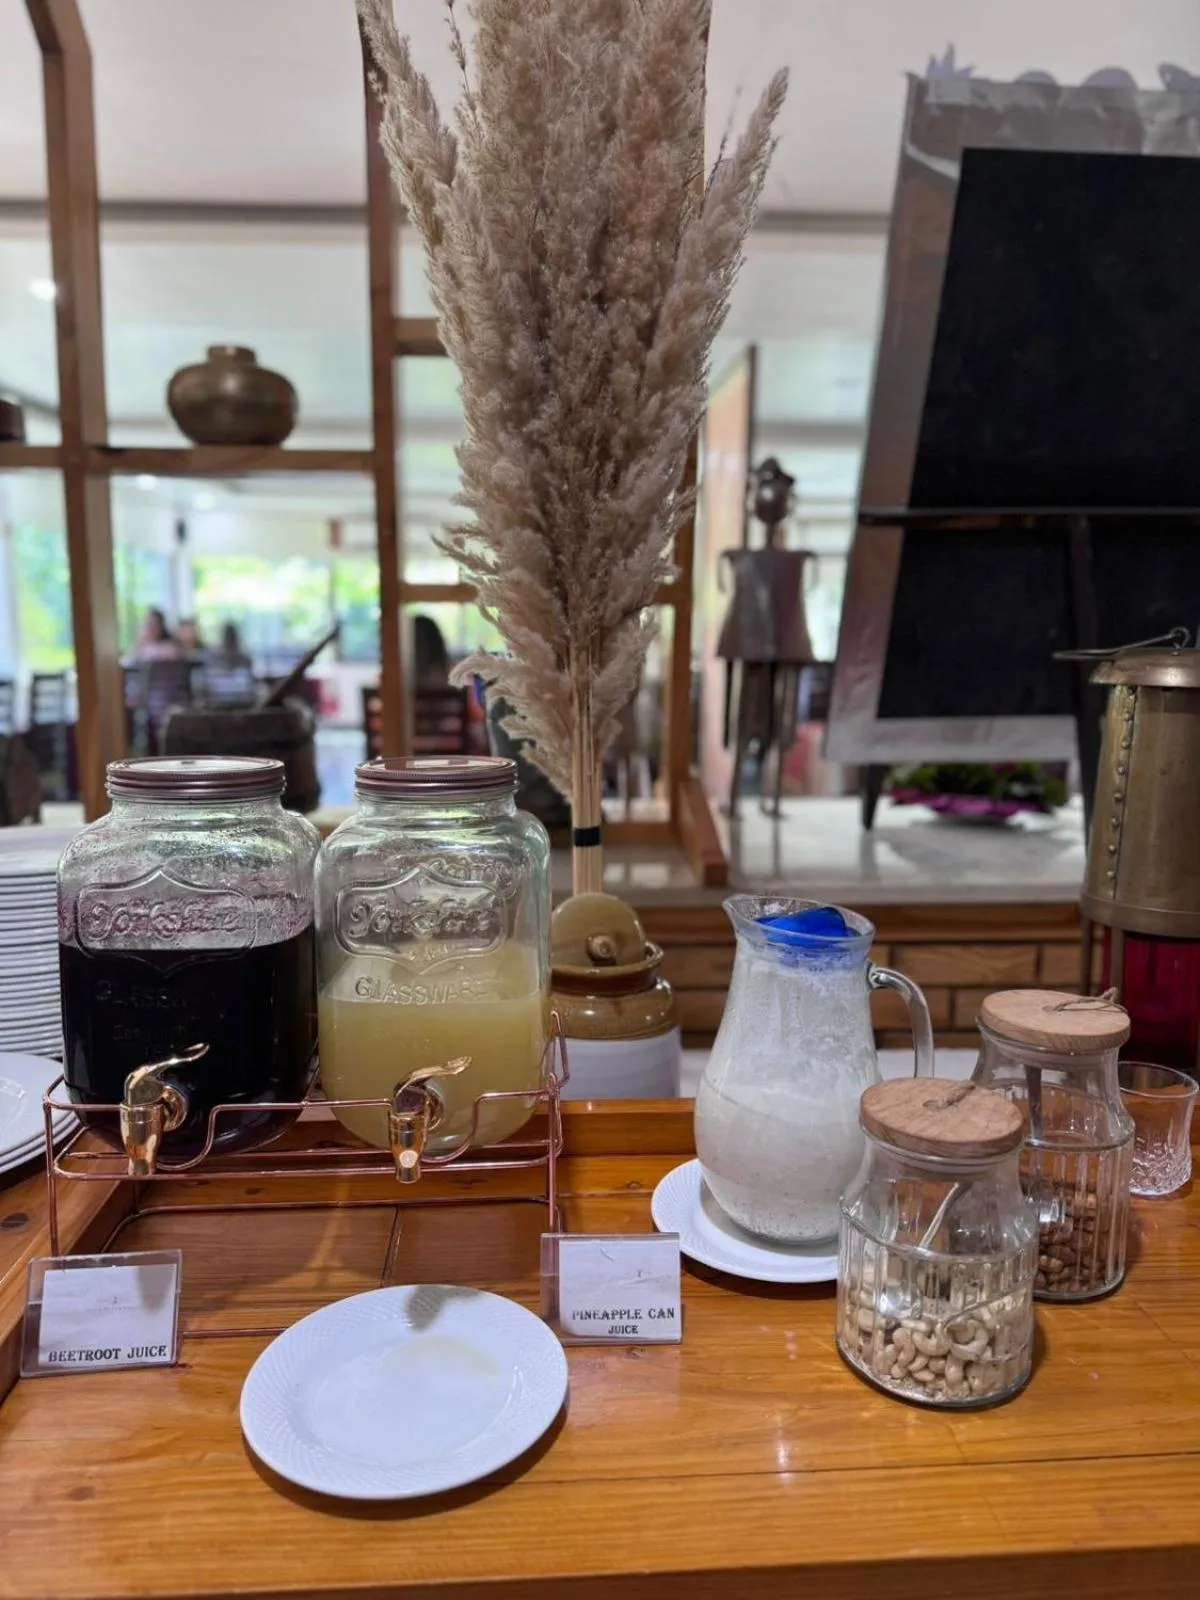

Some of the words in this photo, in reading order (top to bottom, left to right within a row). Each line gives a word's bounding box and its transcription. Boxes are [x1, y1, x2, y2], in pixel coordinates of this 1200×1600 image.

[355, 975, 494, 1005] GLASSWARE
[572, 1308, 642, 1320] PINEAPPLE
[648, 1307, 675, 1319] CAN
[608, 1325, 639, 1335] JUICE
[48, 1348, 121, 1362] BEETROOT
[127, 1345, 167, 1358] JUICE
